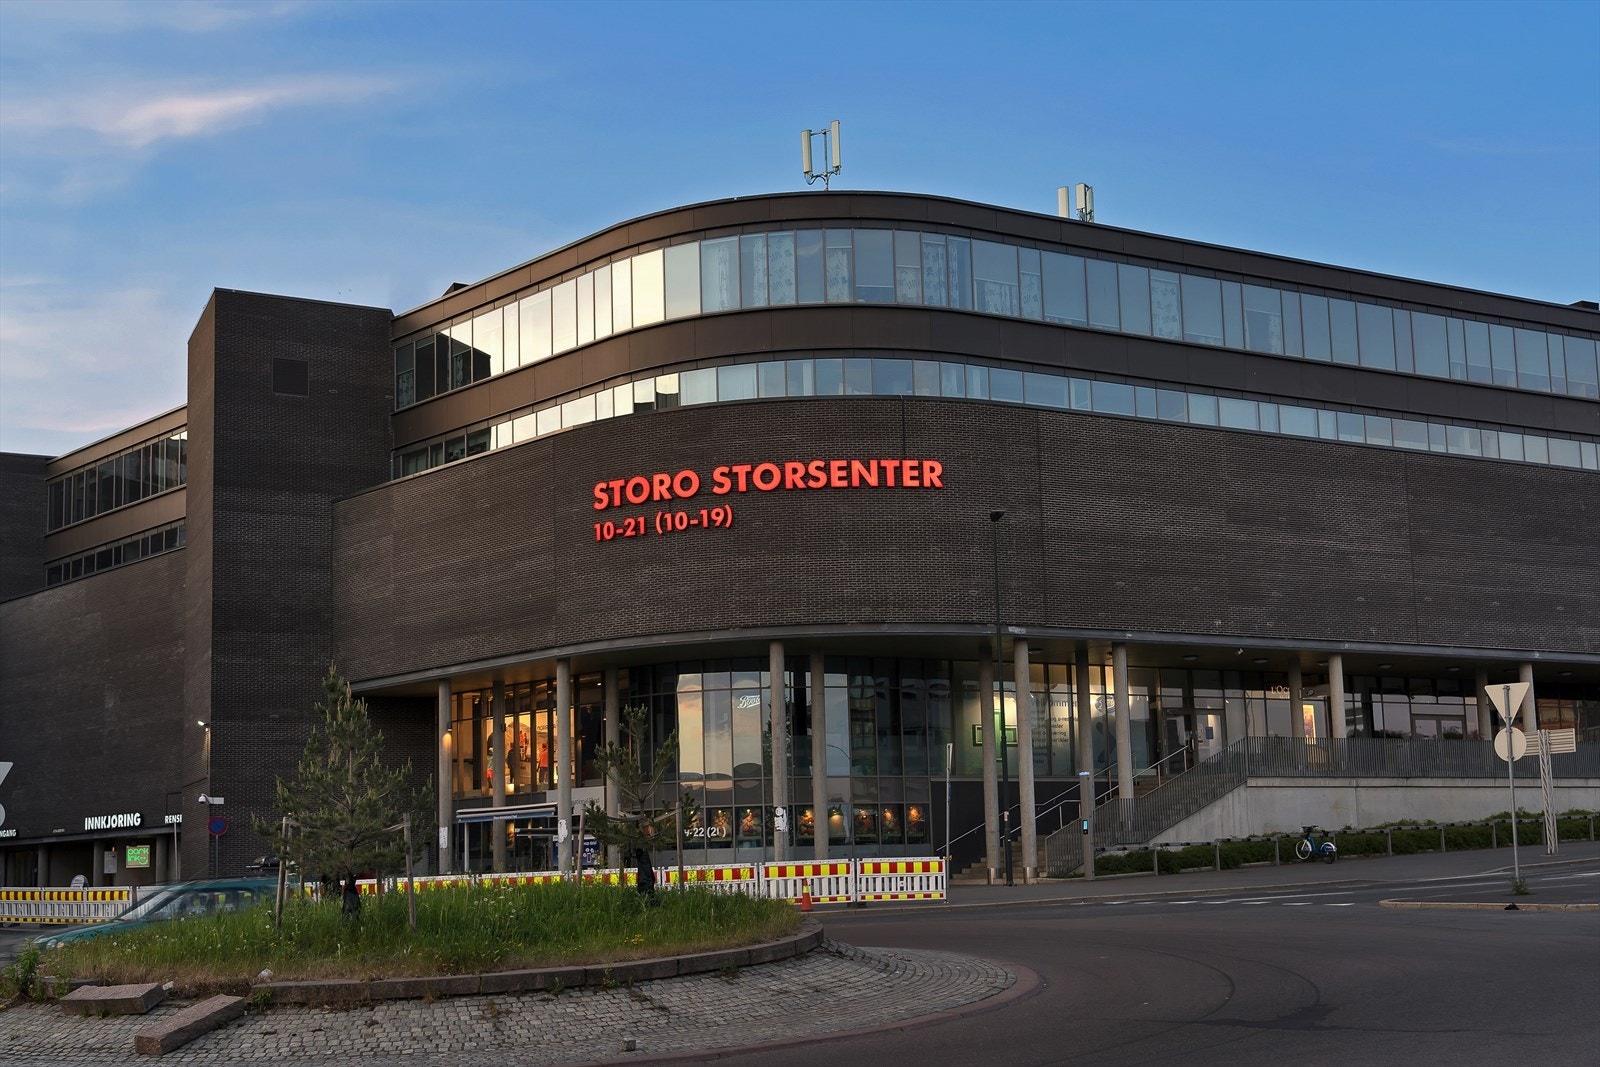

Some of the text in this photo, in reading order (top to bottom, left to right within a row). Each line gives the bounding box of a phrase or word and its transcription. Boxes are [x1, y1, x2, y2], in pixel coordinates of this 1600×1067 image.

[593, 459, 944, 511] STORO STORSENTER
[593, 504, 733, 541] 10-21 (10-19)
[84, 812, 141, 831] INNKJØRING
